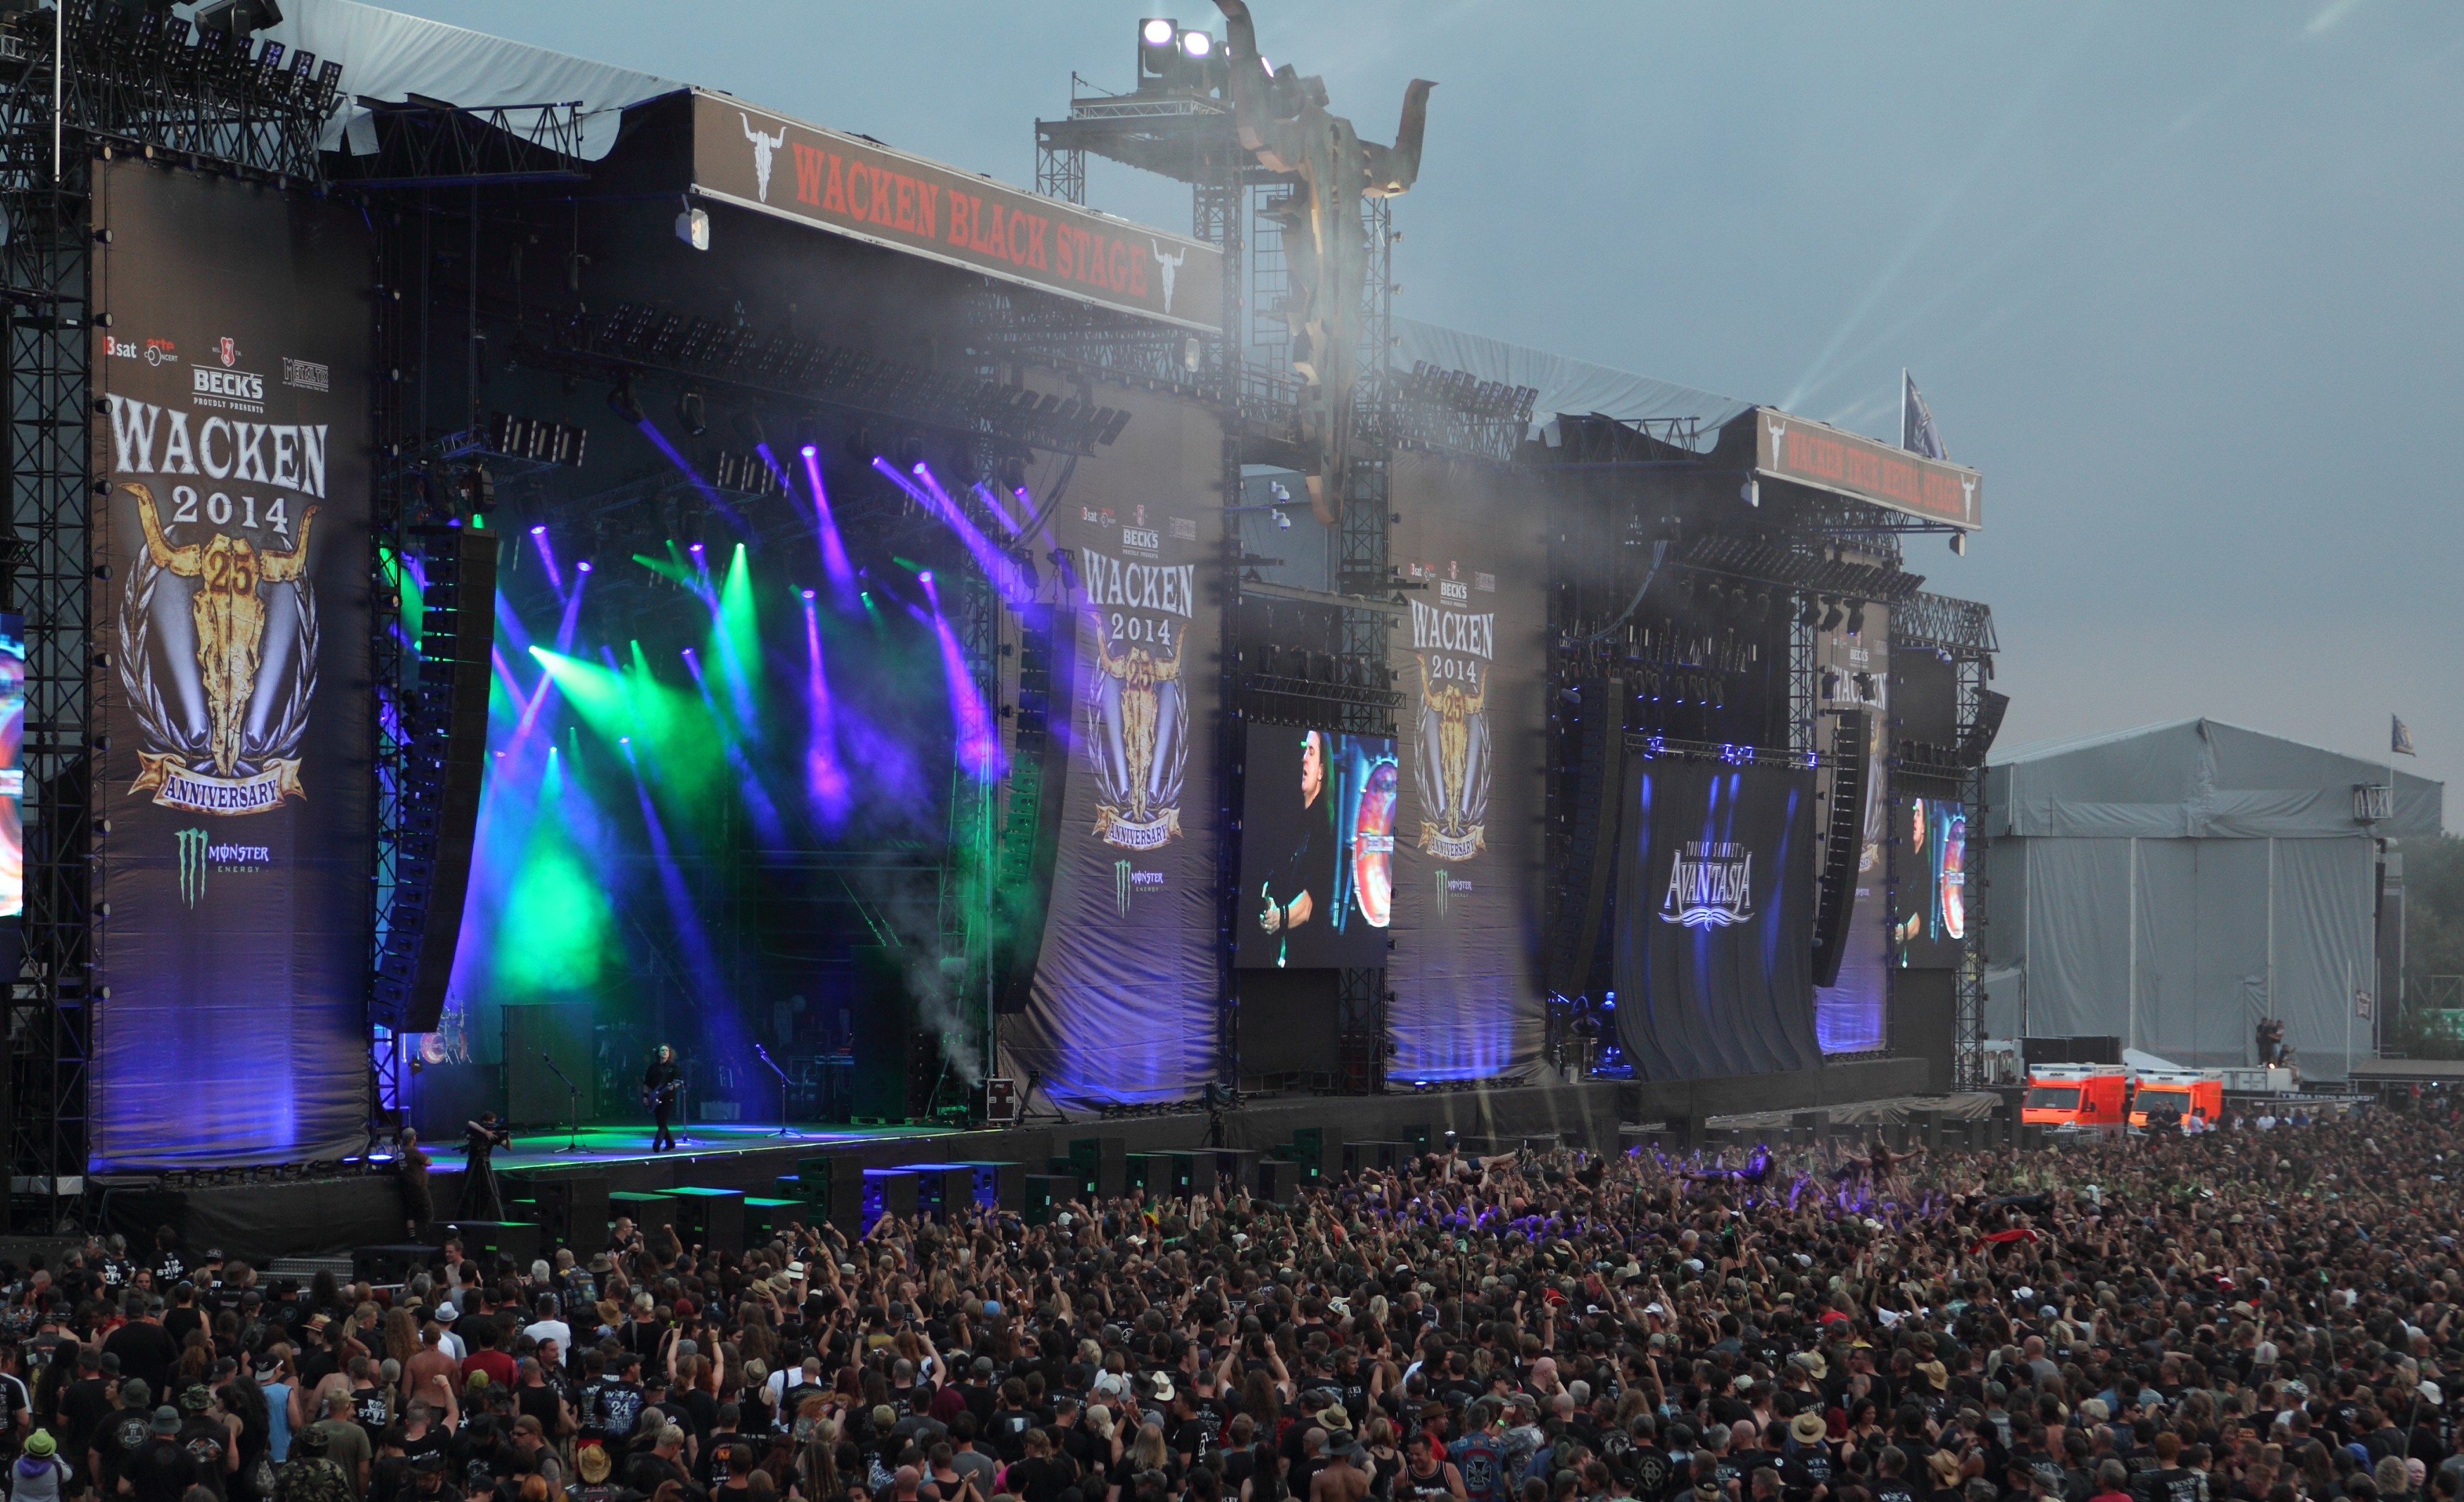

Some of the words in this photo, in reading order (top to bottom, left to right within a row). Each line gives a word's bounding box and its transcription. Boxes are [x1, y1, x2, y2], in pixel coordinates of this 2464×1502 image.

[792, 142, 938, 240] WACKEN
[947, 189, 1049, 273] BLACK
[1056, 222, 1148, 298] STAGE
[106, 336, 137, 358] 3sat
[146, 338, 174, 351] arte
[194, 369, 263, 399] BECK'S
[194, 397, 226, 408] PROUDLY
[230, 401, 264, 413] PRESENTS
[105, 392, 329, 499] WACKEN
[172, 486, 289, 534] 2014
[1123, 528, 1159, 549] BECK'S
[209, 551, 252, 595] 25
[1082, 547, 1195, 618] WACKEN
[1440, 581, 1467, 599] BECK'S
[1111, 613, 1171, 645] 2014
[1411, 599, 1495, 660] WACKEN
[1129, 659, 1152, 691] 25
[1432, 654, 1476, 684] 2014
[1445, 695, 1462, 723] 25
[164, 775, 277, 808] ANNIVERSARY
[1109, 822, 1167, 845] ANNIVERSARY
[1431, 837, 1475, 857] ANNIVERSARY
[209, 843, 269, 863] MONSTER
[1686, 841, 1709, 857] TOBIAS
[1131, 870, 1163, 884] MONSTER
[1664, 849, 1753, 914] AVANTASIA
[611, 1401, 630, 1415] 24
